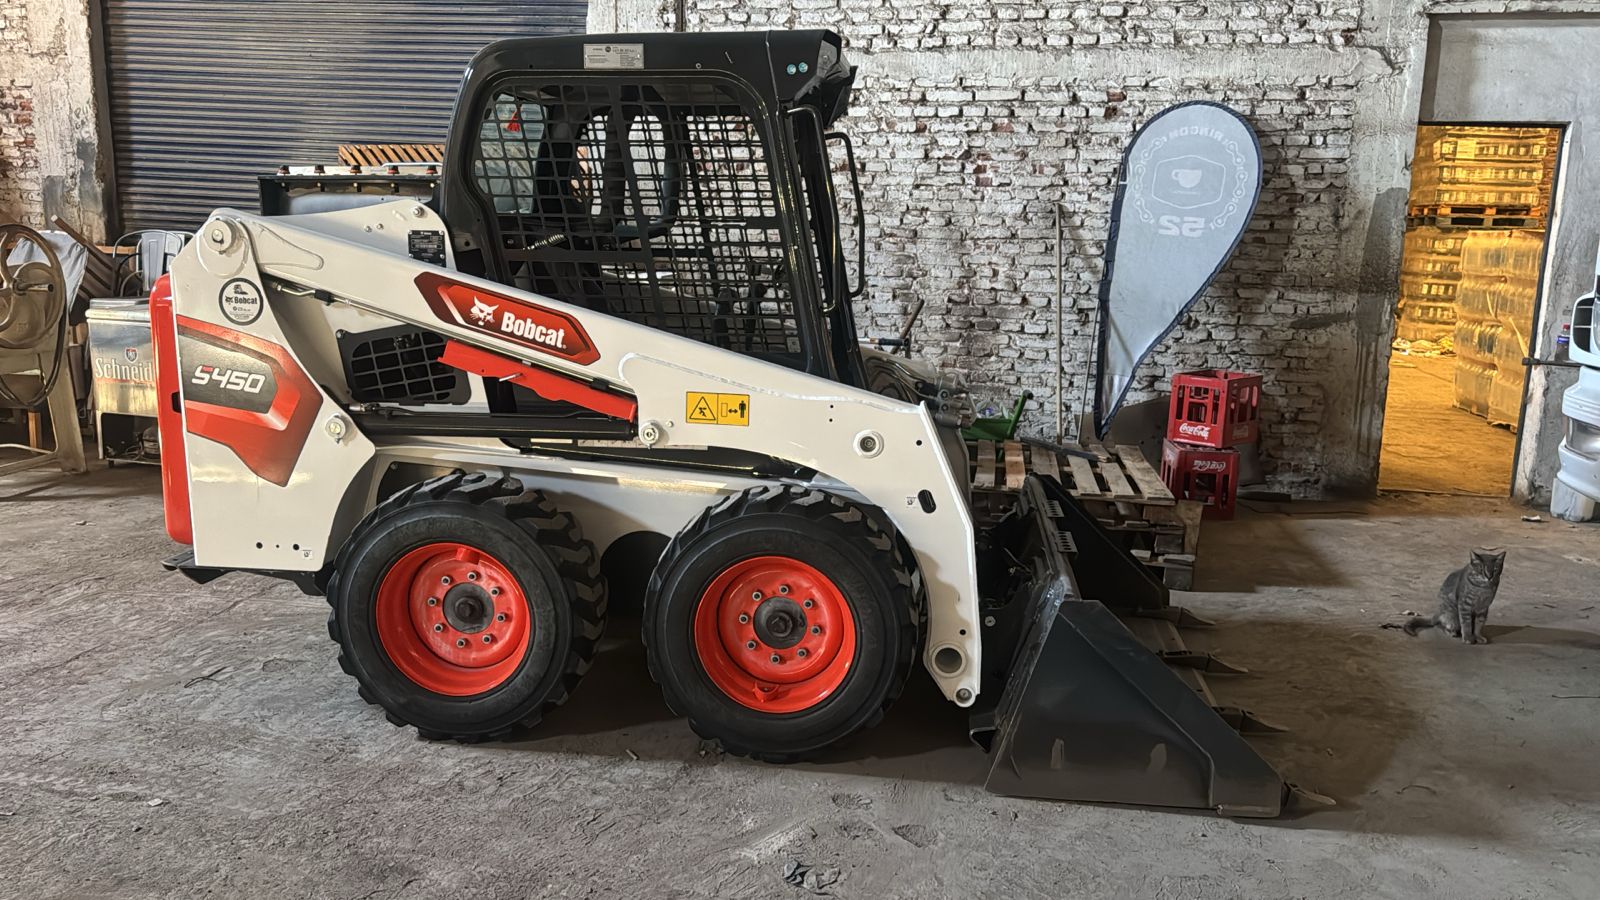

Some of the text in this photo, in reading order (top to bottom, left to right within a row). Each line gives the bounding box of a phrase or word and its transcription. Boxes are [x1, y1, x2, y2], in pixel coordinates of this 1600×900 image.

[234, 296, 257, 304] Bobcat
[501, 311, 565, 349] Bobcat
[192, 365, 265, 393] S450
